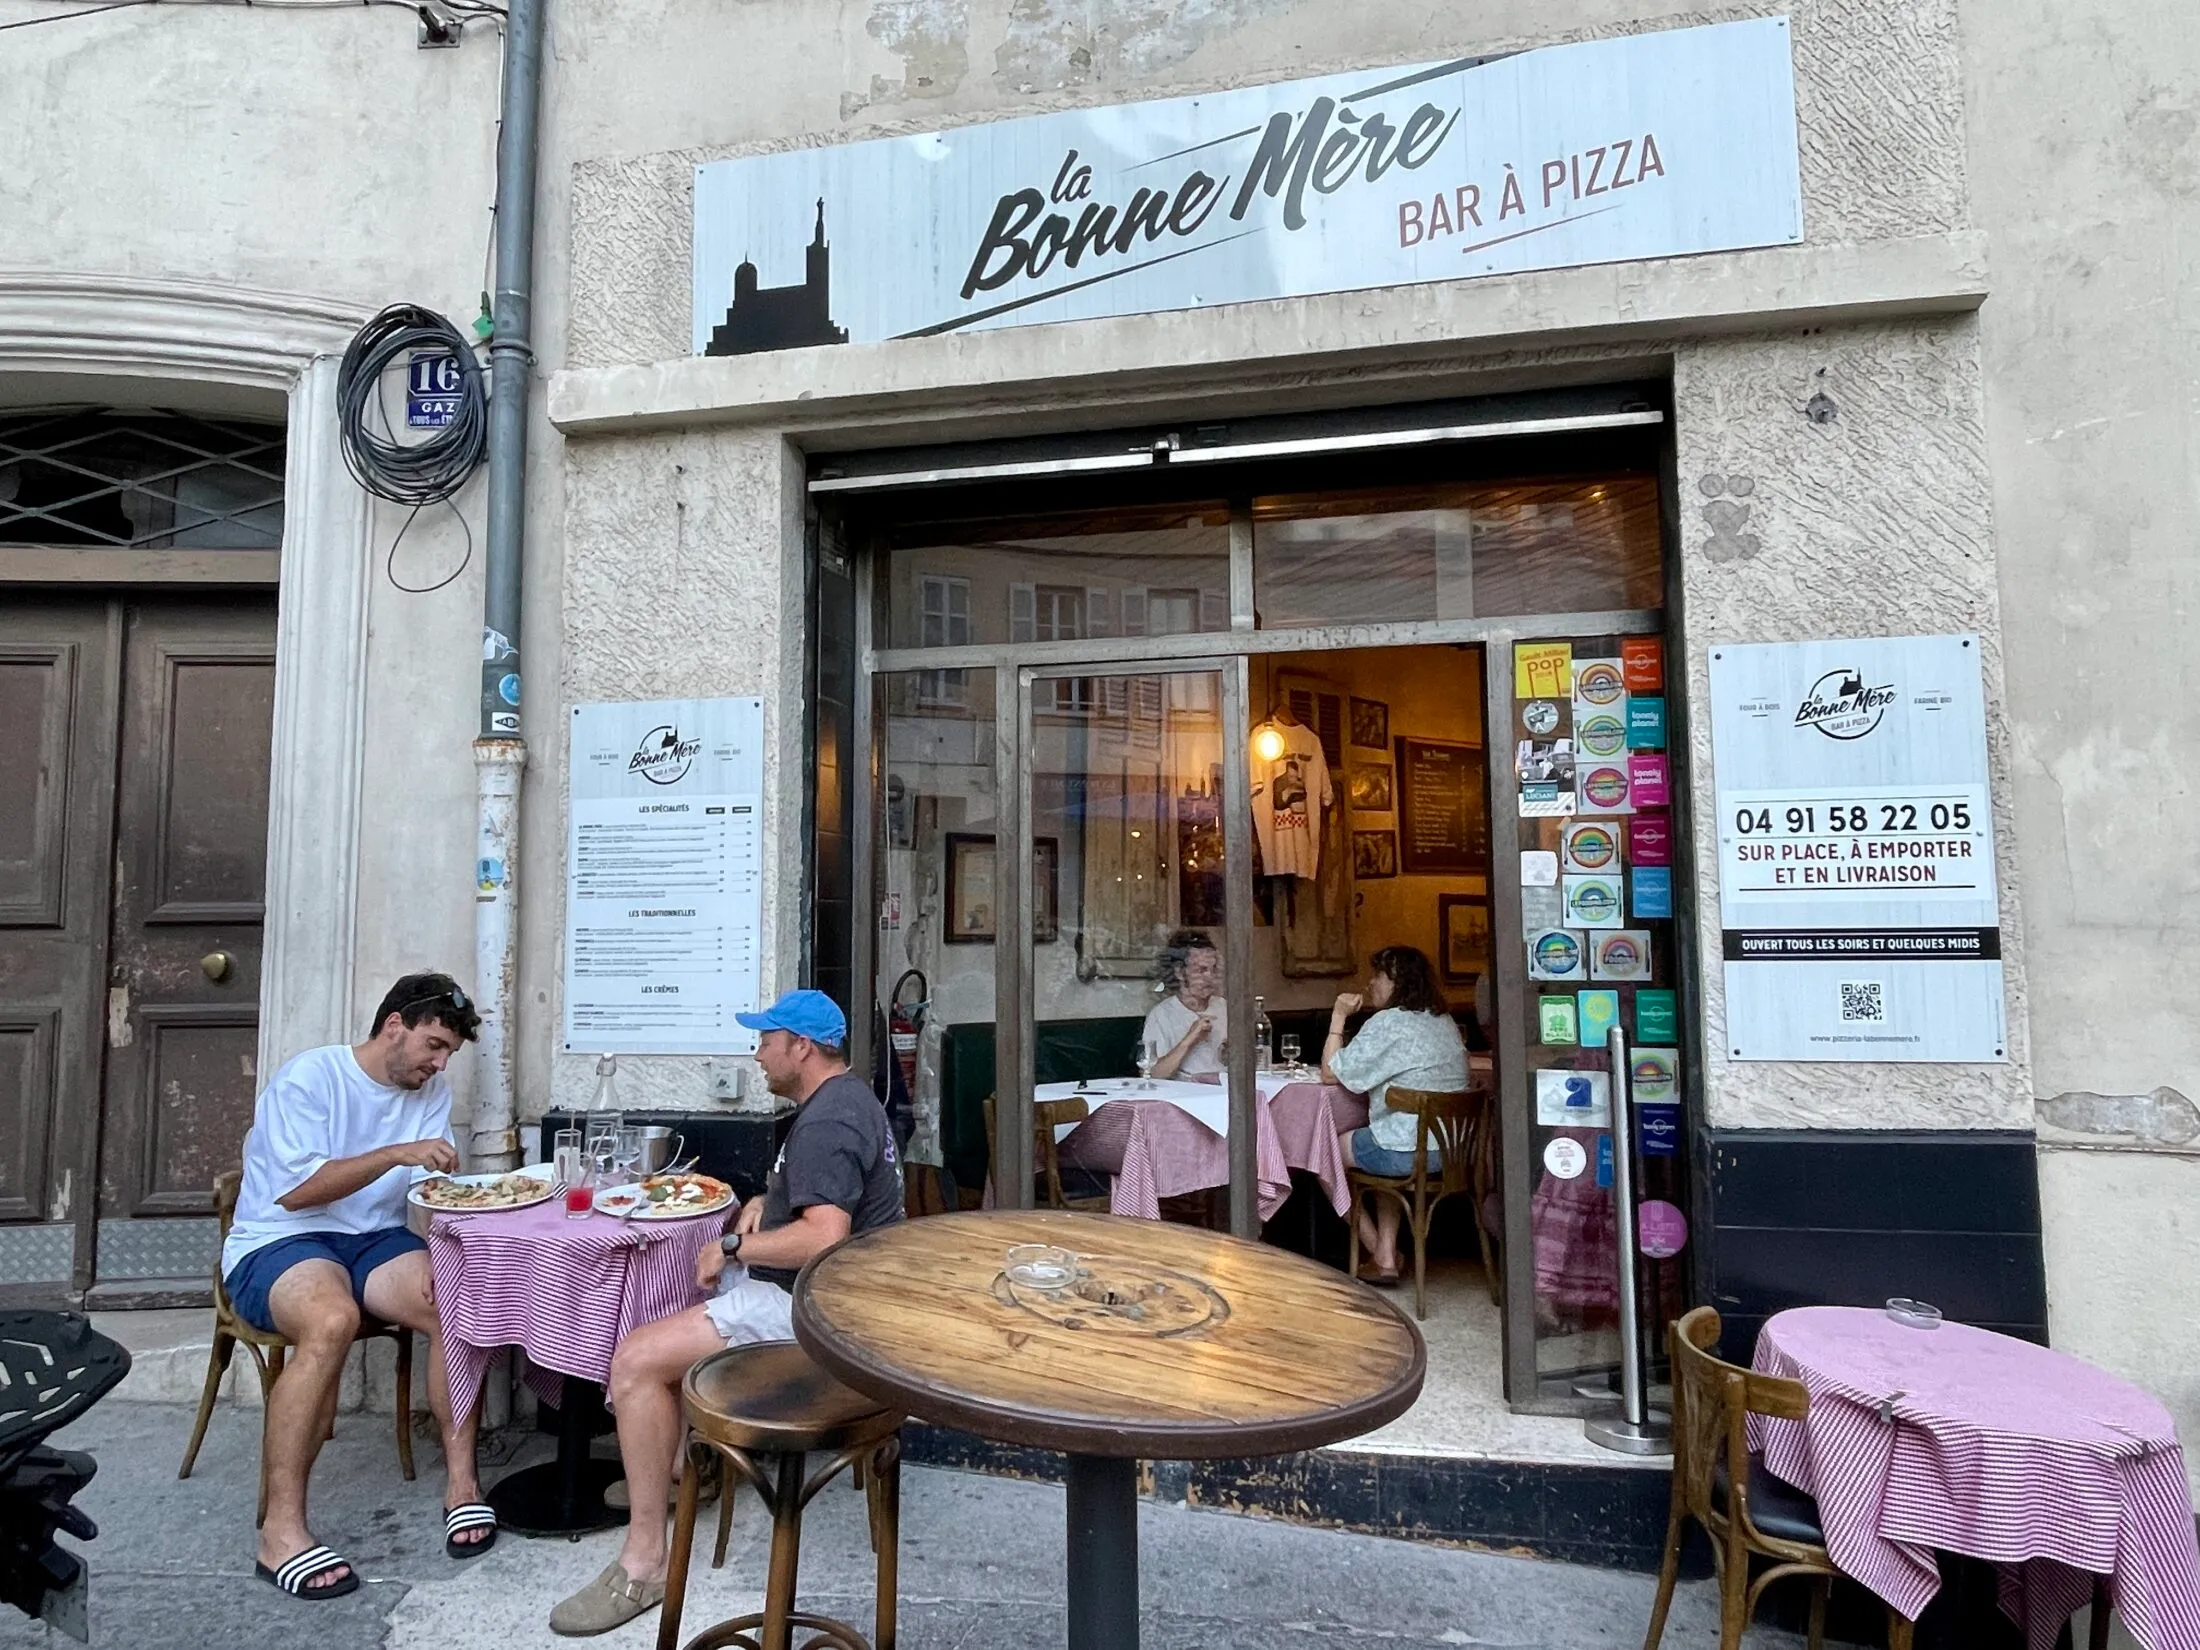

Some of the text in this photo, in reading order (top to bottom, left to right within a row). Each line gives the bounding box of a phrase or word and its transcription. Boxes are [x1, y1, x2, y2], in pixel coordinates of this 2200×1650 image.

[1051, 149, 1092, 204] la
[960, 96, 1461, 300] Bonne Mère
[1400, 134, 1665, 248] BAR À PIZZA
[416, 356, 460, 391] 16
[413, 415, 430, 425] TOUS
[421, 402, 455, 413] GAZ
[1795, 687, 1896, 722] Bonne Mère
[628, 751, 668, 769] Bonne
[1736, 803, 1971, 834] 04 91 58 22 05
[1738, 838, 1972, 862] SUR PLACE, À EMPORTER
[1775, 864, 1936, 884] ET EN LIVRAISON
[1742, 937, 1980, 950] OUVERT TOUS LES SOIRS ET QUELQUES MIDIS
